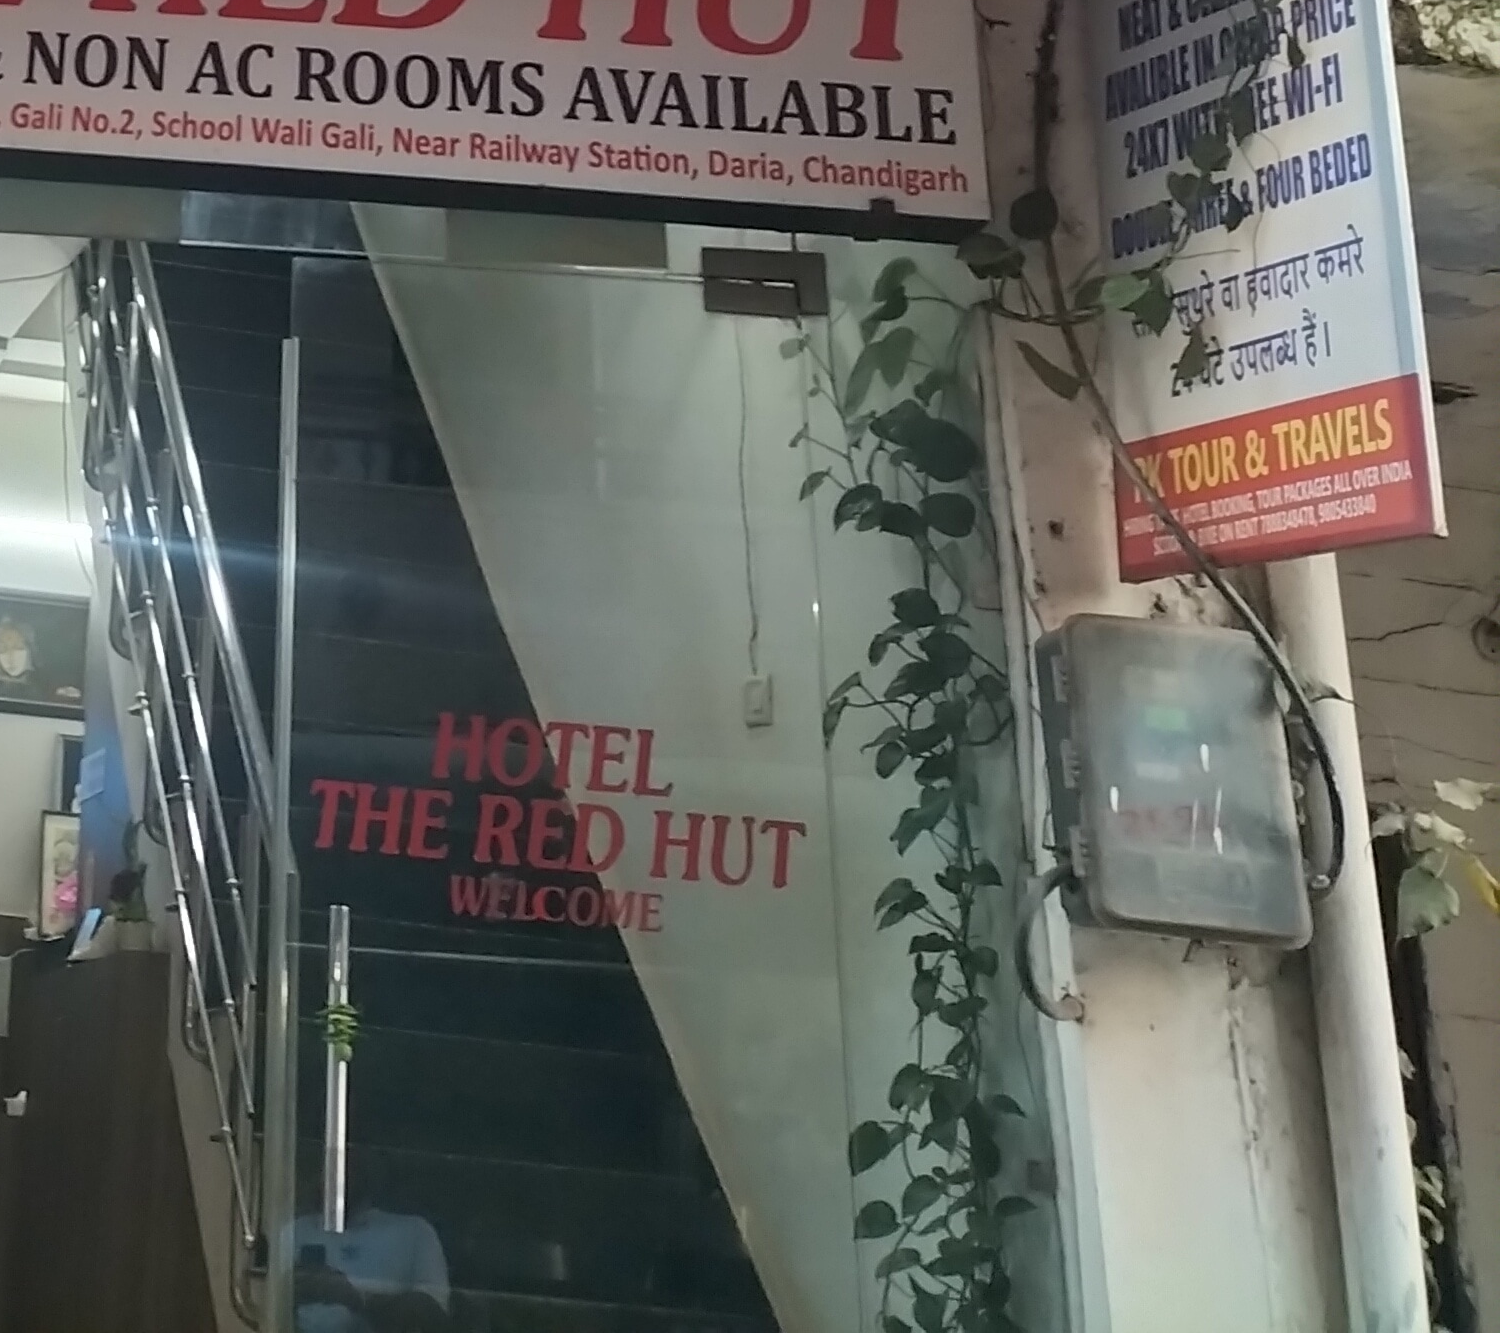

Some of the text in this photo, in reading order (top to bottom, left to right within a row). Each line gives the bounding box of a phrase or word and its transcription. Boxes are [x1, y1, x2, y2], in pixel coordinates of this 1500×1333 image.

[24, 29, 170, 91] NON
[187, 39, 274, 100] AC
[295, 47, 546, 118] ROOMS
[563, 65, 957, 145] AVAILABLE
[1283, 52, 1343, 120] WI-FI
[11, 102, 64, 132] Gali
[71, 108, 144, 140] No.2,
[152, 111, 242, 142] School
[251, 118, 313, 147] Wali
[320, 121, 384, 156] Gali,
[393, 128, 461, 157] Near
[470, 133, 580, 170] Railway
[588, 142, 698, 177] Station,
[709, 149, 794, 185] Daria,
[802, 156, 969, 196] Chandigarh
[1256, 155, 1306, 213] FOUR
[1308, 132, 1372, 195] BEDED
[1314, 223, 1365, 284] कमरे
[1167, 435, 1241, 495] TOUR
[1244, 429, 1270, 479] &
[1271, 397, 1394, 472] TRAVELS
[1333, 471, 1353, 494] ALL
[1352, 465, 1381, 491] OVER
[430, 711, 673, 797] HOTEL
[309, 778, 808, 889] THE RED HUT
[449, 874, 664, 933] WELCOME
